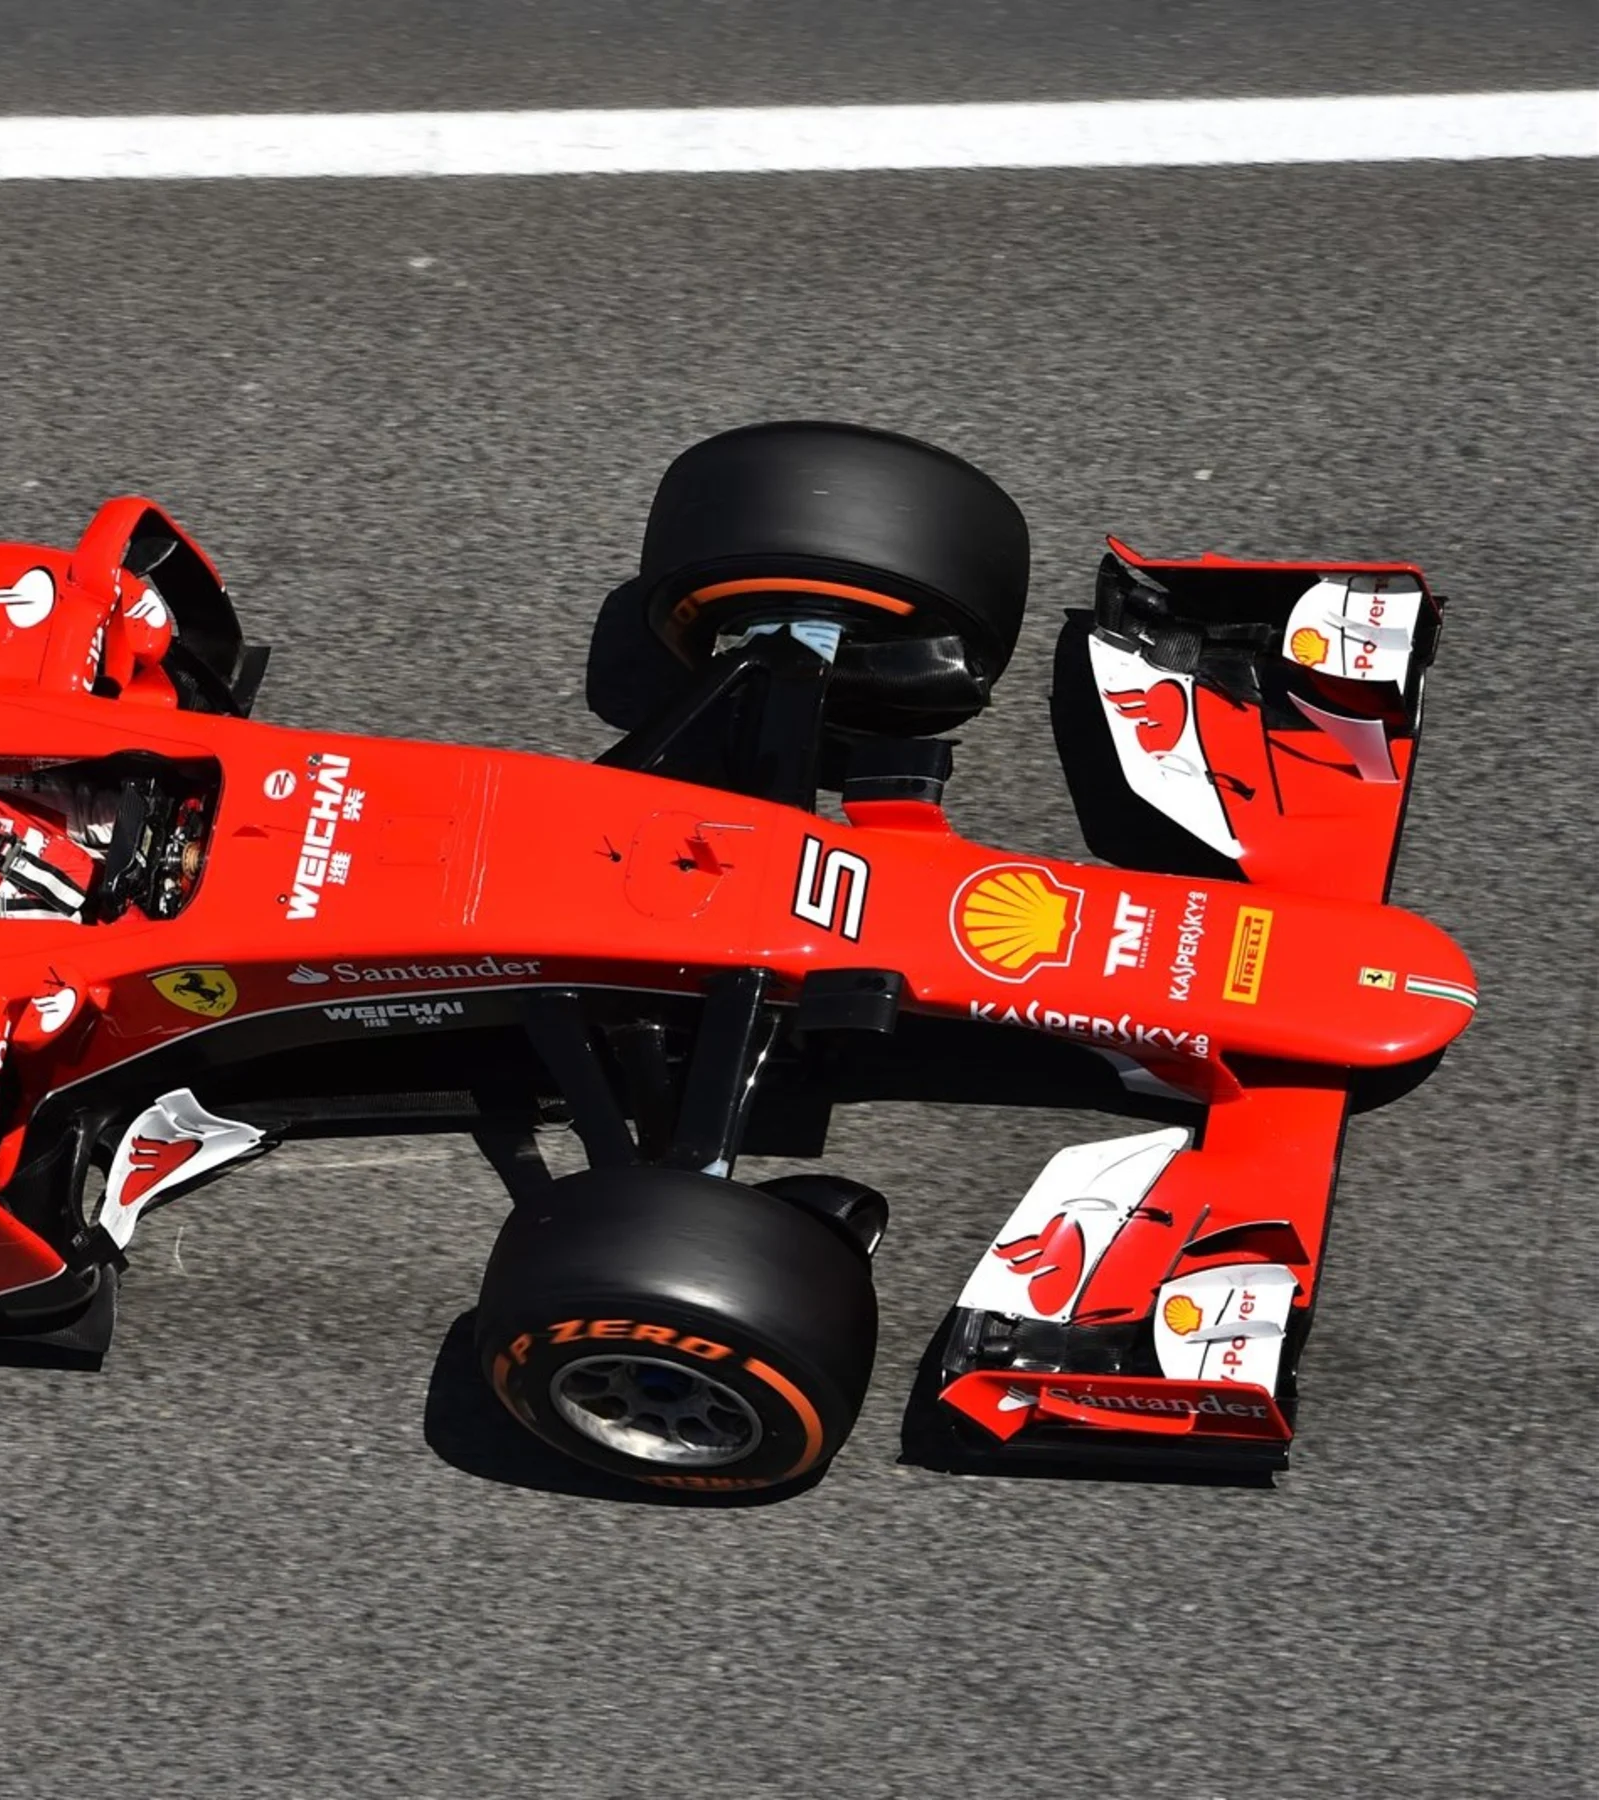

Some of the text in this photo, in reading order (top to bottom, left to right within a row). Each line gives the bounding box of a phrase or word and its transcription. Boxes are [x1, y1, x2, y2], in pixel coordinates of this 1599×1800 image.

[286, 753, 350, 920] WEICHAI
[791, 833, 871, 943] 5
[332, 956, 542, 983] Santander
[1103, 891, 1148, 977] TNT
[1168, 899, 1205, 1000] KASPERSKY
[1232, 916, 1264, 994] PIRELLI
[323, 1001, 464, 1020] WEICHAI
[970, 1000, 1189, 1050] KASPERSKY
[548, 1319, 735, 1362] ZERO
